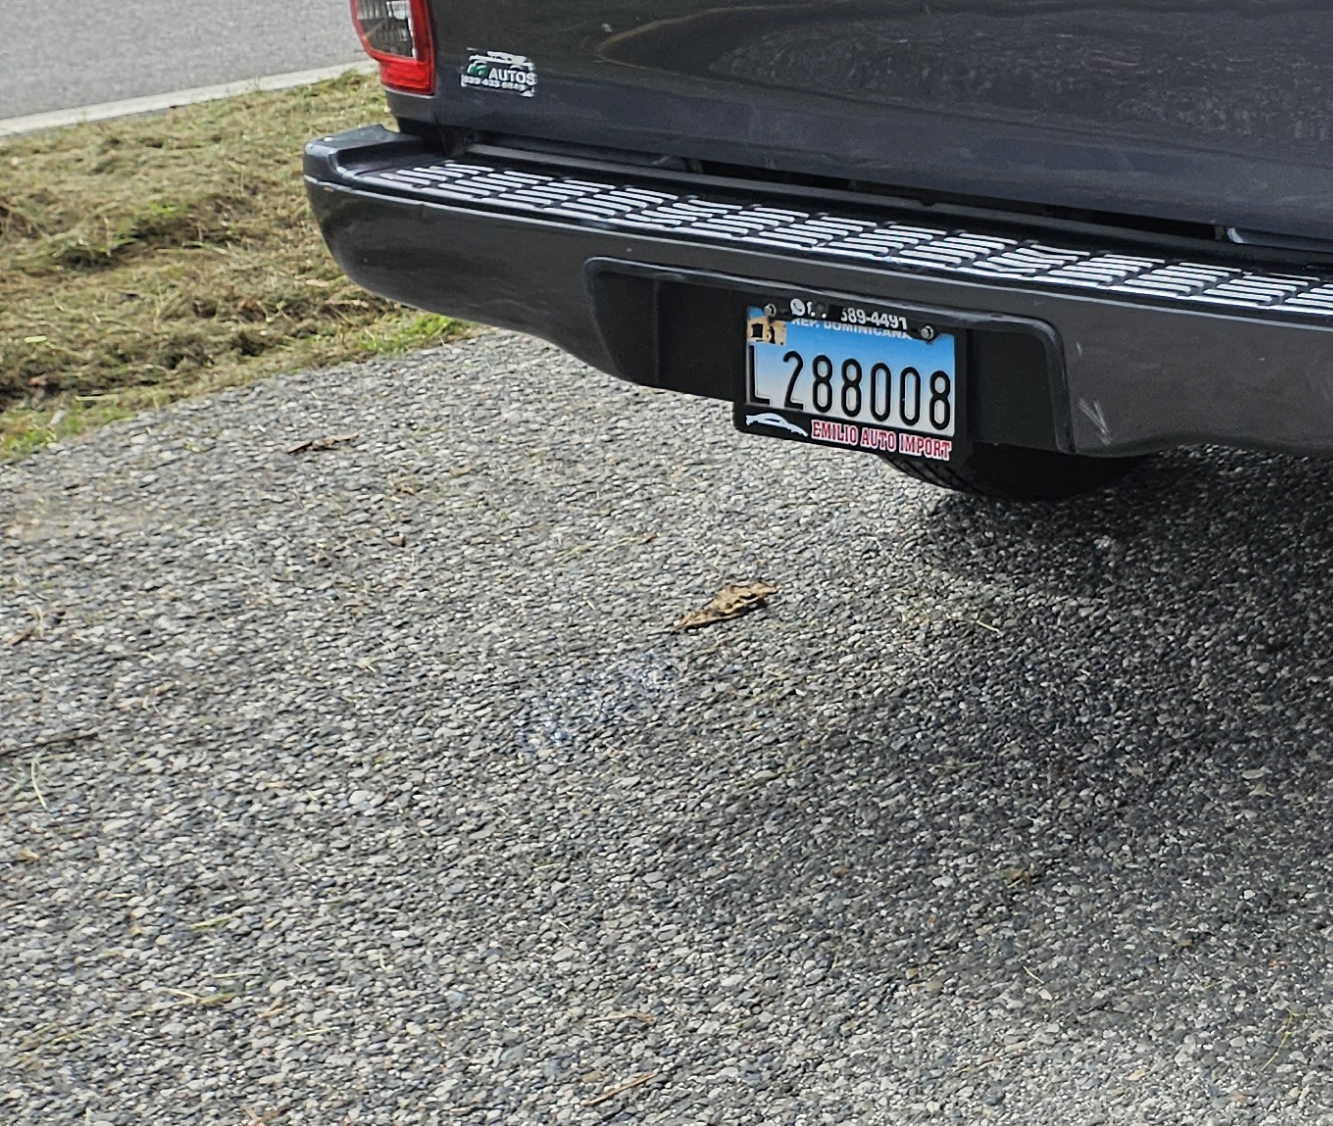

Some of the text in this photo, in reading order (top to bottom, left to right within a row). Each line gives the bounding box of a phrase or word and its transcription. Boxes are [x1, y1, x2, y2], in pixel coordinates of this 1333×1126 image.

[488, 68, 537, 86] AUTOS
[811, 419, 952, 461] EMILIO AUTO IMPORT
